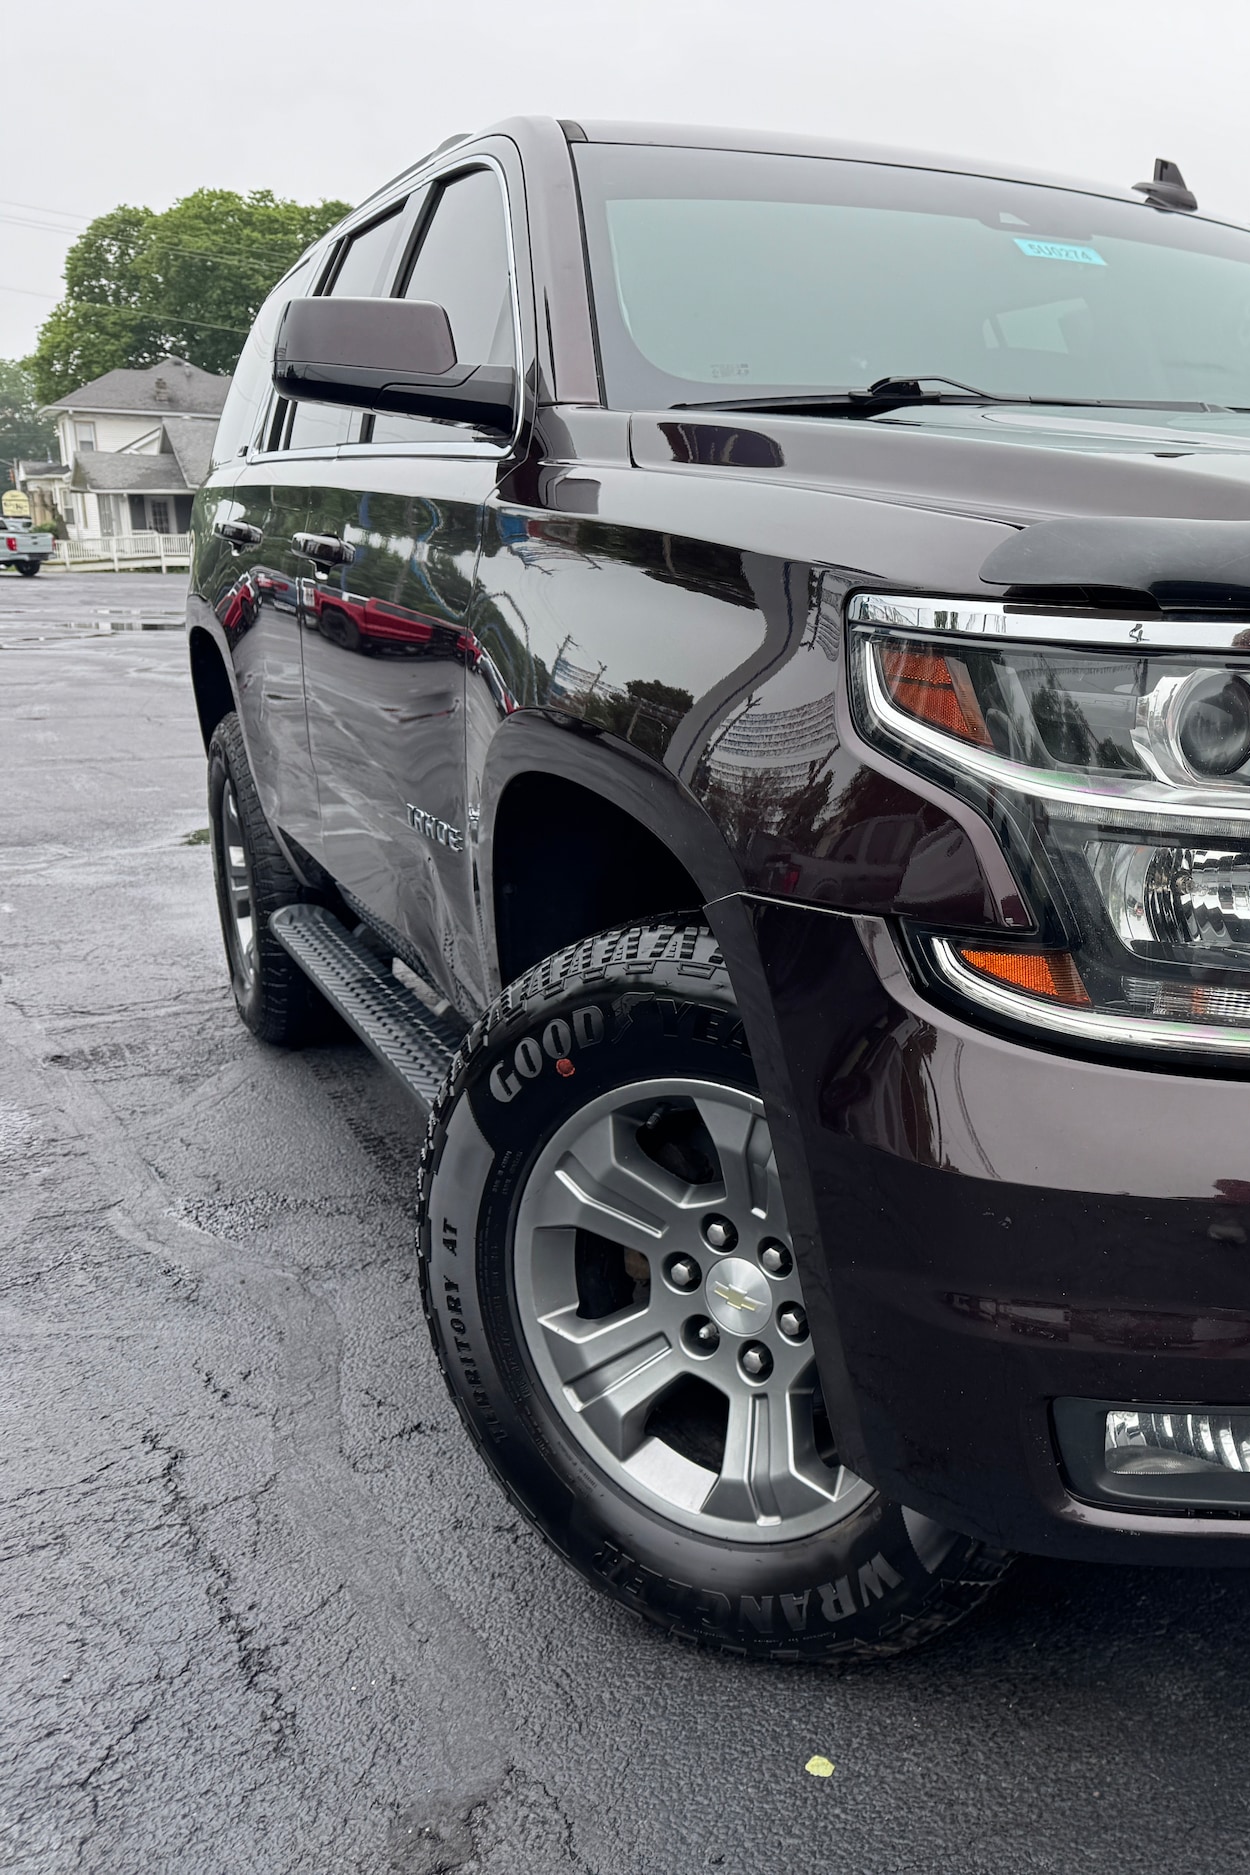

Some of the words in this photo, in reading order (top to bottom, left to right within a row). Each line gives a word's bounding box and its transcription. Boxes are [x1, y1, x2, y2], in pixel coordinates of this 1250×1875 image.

[406, 802, 463, 852] TAHOE
[441, 1216, 459, 1257] AT
[442, 1273, 509, 1444] TERRITORY
[591, 1540, 906, 1634] WRANGLER
